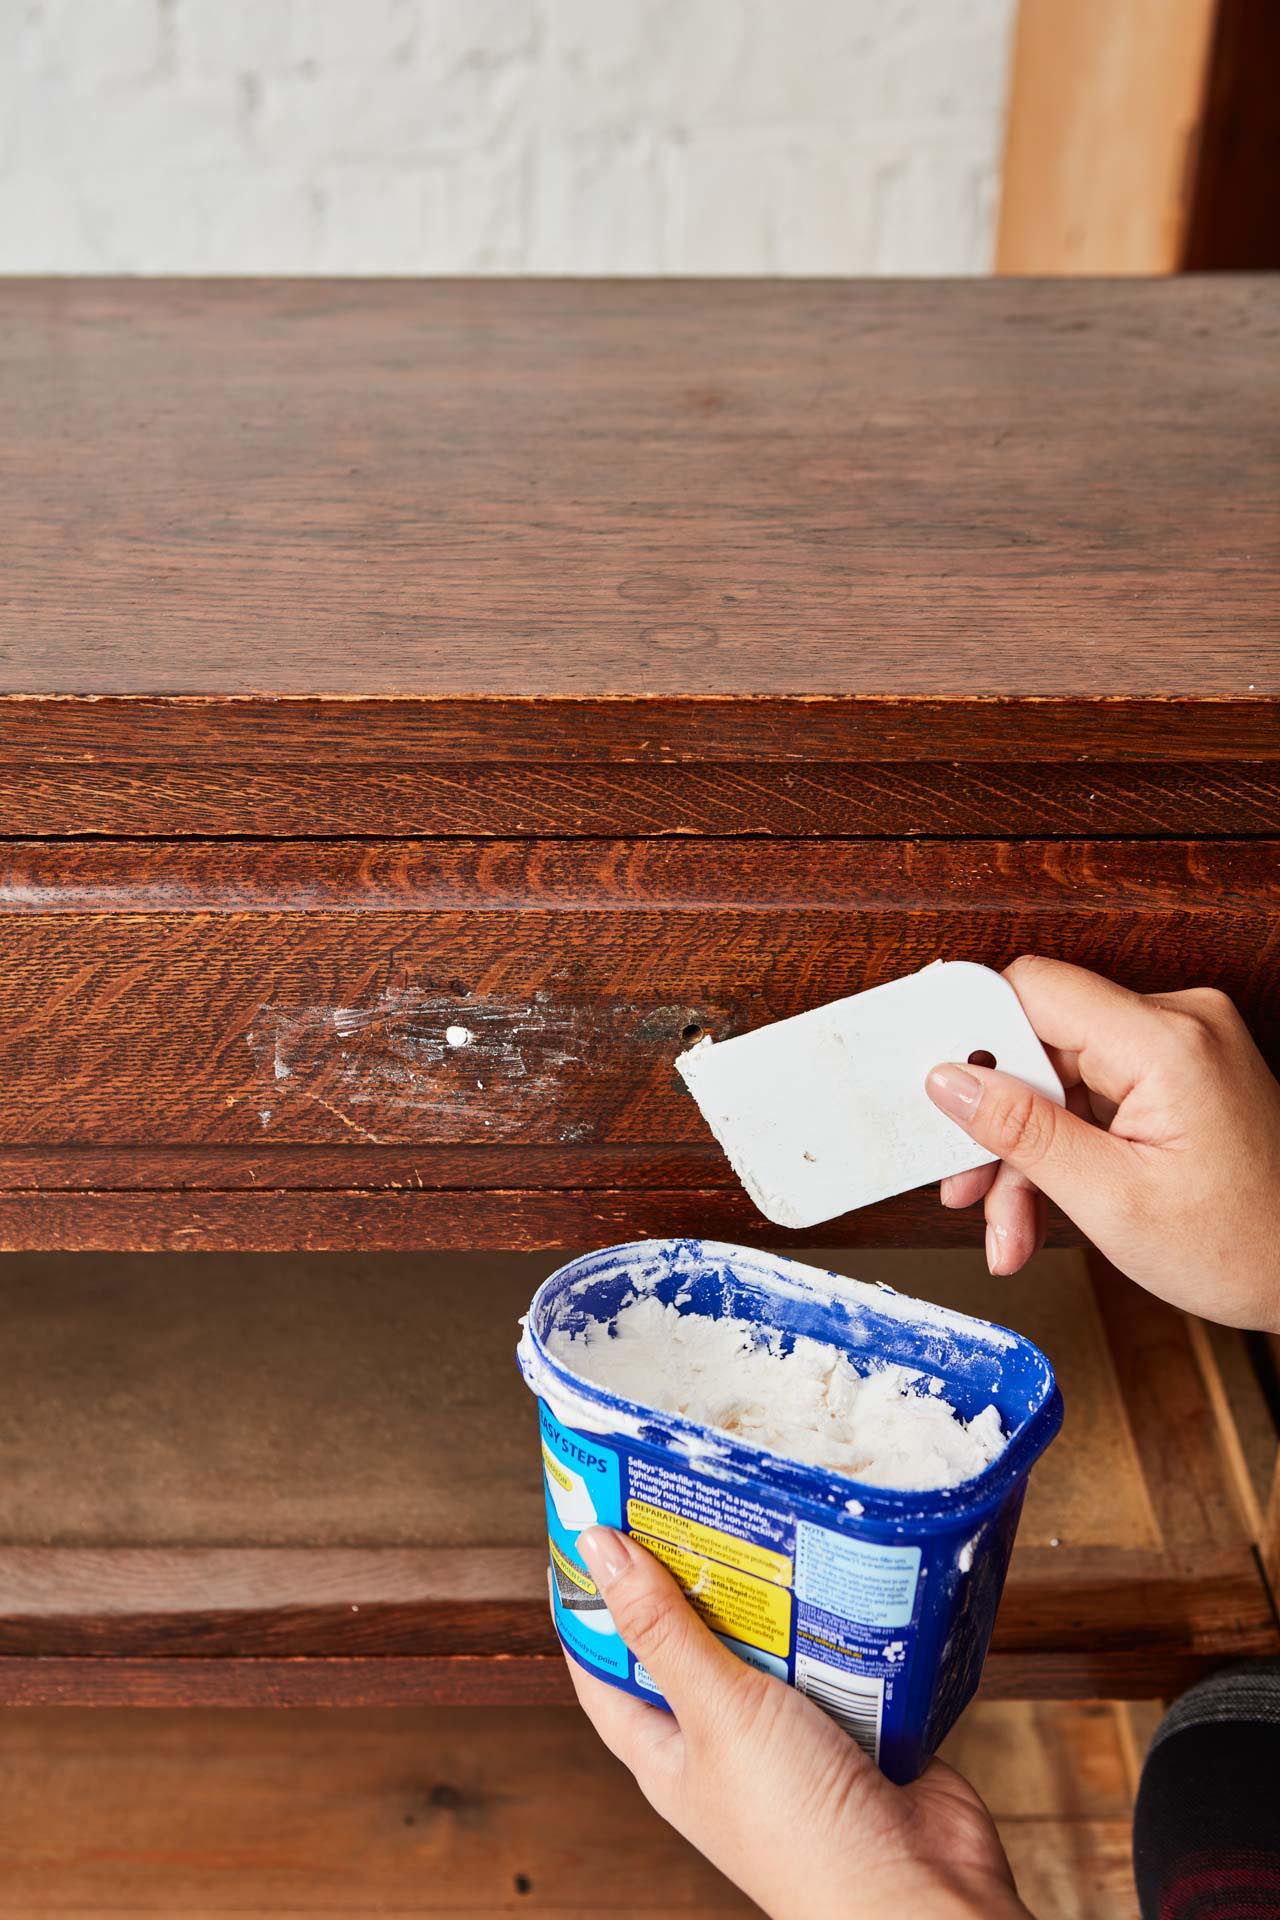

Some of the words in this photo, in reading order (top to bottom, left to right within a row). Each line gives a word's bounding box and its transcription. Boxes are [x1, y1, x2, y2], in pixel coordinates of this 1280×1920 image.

[562, 1438, 607, 1474] STEPS
[628, 1465, 674, 1492] lightweight
[675, 1483, 694, 1499] filler
[695, 1490, 712, 1506] that
[713, 1498, 720, 1509] is
[629, 1475, 662, 1498] virtually
[663, 1489, 722, 1521] non-shrinking,
[629, 1487, 635, 1497] &
[636, 1489, 660, 1506] needs
[662, 1499, 680, 1515] only
[682, 1508, 697, 1520] one
[726, 1491, 732, 1503] is
[733, 1497, 739, 1505] a
[739, 1497, 791, 1525] ready-mixed
[730, 1586, 747, 1598] Rapid
[590, 1647, 598, 1658] to
[598, 1652, 618, 1667] paint
